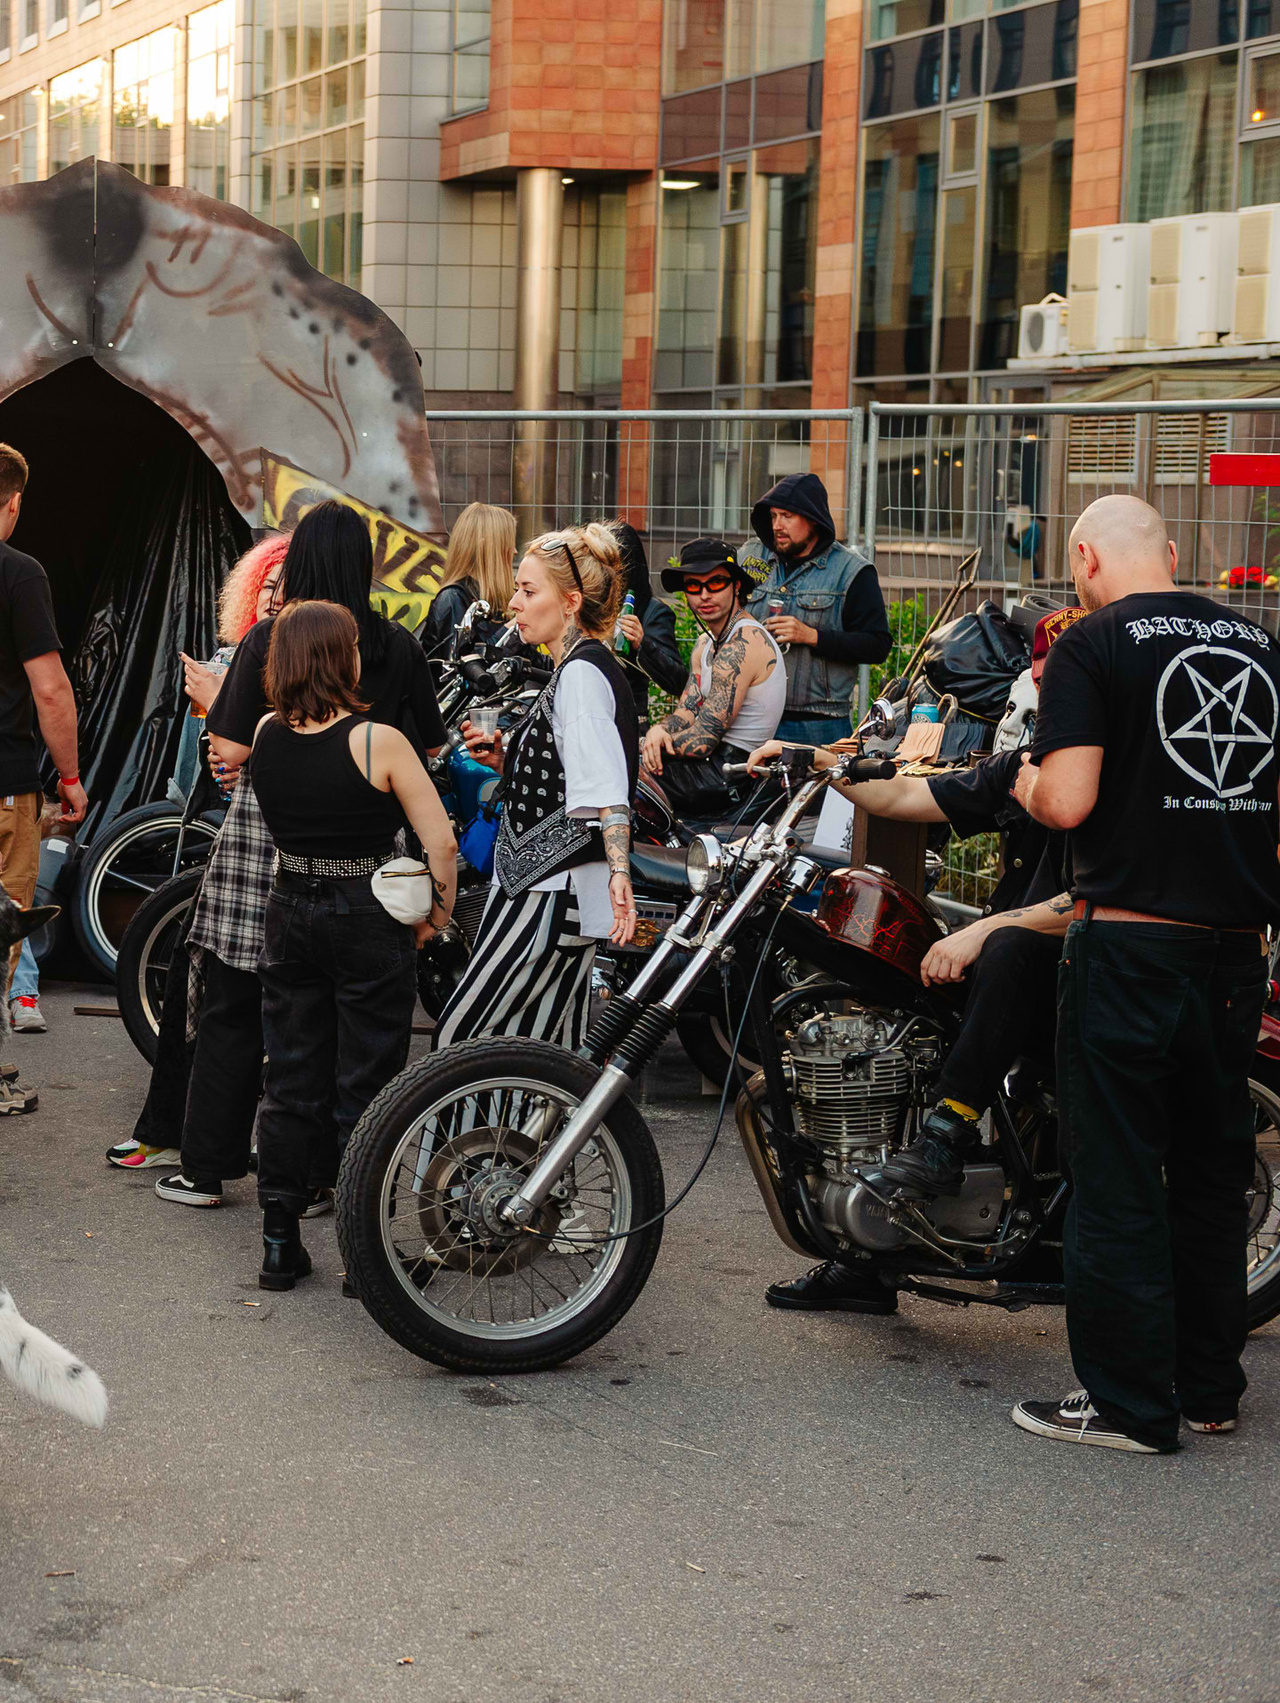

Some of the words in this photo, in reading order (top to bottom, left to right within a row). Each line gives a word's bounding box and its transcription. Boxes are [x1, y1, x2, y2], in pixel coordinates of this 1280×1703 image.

[1125, 616, 1271, 651] BATHORY
[1163, 795, 1180, 809] In
[1229, 798, 1258, 813] With
